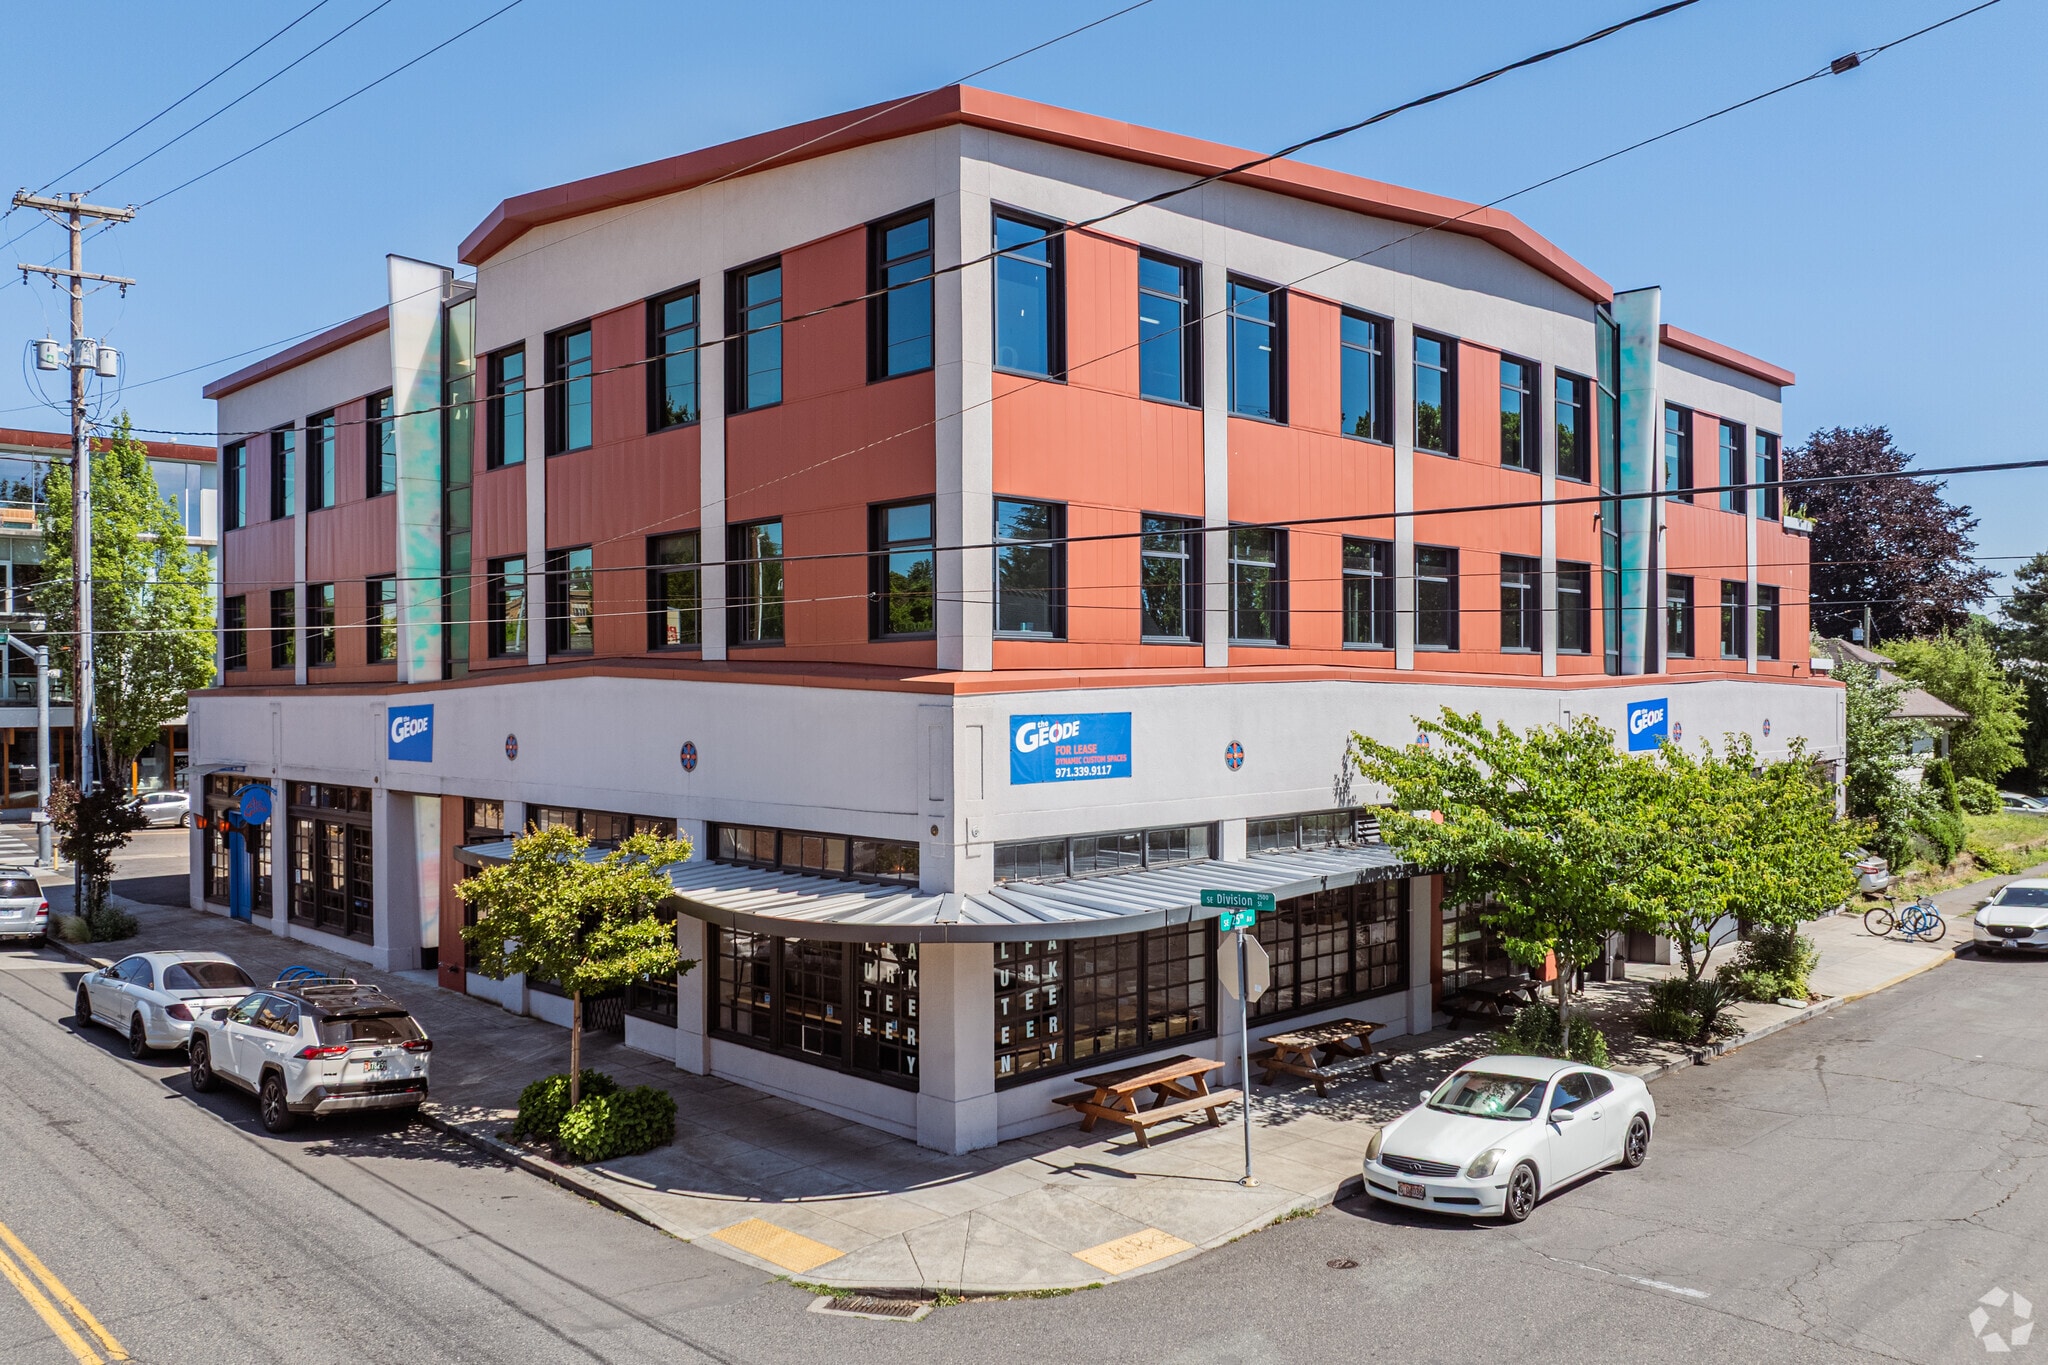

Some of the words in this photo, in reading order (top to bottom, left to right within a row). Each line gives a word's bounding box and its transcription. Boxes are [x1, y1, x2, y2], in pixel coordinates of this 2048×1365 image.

[391, 716, 429, 743] GEODE
[1037, 720, 1049, 729] the
[1630, 708, 1664, 734] GEODE
[1015, 720, 1080, 753] GEODE
[1055, 745, 1071, 755] FOR
[1073, 743, 1098, 754] LEASE
[1055, 757, 1082, 765] DYNAMIC
[1083, 755, 1106, 764] CUSTOM
[1107, 754, 1127, 762] SPACES
[1055, 764, 1112, 778] 971.339.9117
[1206, 896, 1214, 904] SE
[1216, 893, 1253, 906] Division
[885, 942, 894, 1040] FREE
[1025, 941, 1035, 1039] FREE
